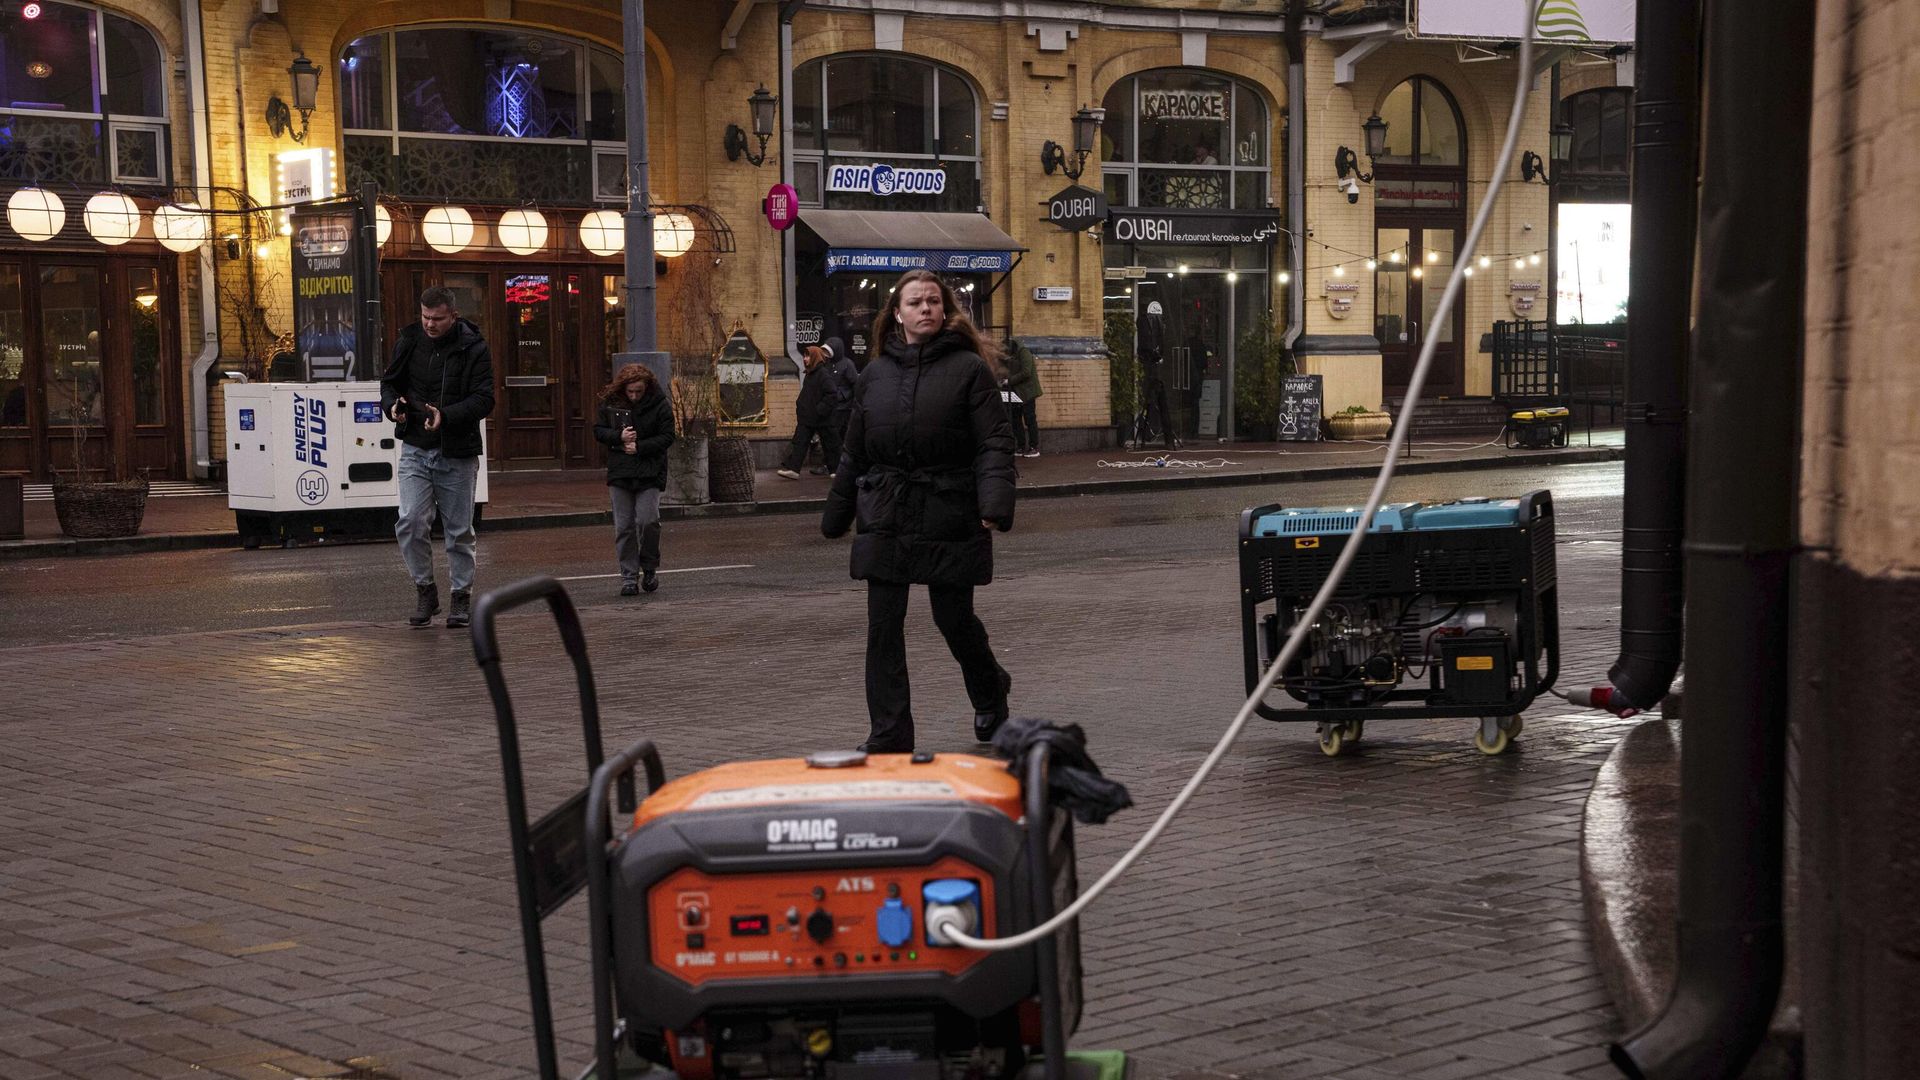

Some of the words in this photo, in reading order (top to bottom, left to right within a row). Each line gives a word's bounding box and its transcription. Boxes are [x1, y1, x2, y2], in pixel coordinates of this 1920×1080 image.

[1143, 94, 1222, 117] КАРАОКЕ
[833, 168, 870, 189] ASIA
[896, 171, 943, 191] FOODS
[771, 194, 787, 209] TIKI
[1051, 197, 1095, 219] DUBAI
[1116, 218, 1172, 241] DUBAI
[1173, 234, 1211, 242] restaurant
[1212, 232, 1240, 242] karaoke
[1240, 233, 1253, 242] bar
[1253, 221, 1277, 242] دبي
[314, 257, 340, 271] ДИНАМО
[851, 253, 888, 266] АЗІЙСЬКИХ
[891, 256, 925, 267] ПРОДУКТІВ
[948, 256, 968, 268] ASIA
[977, 256, 1000, 269] FOODS
[294, 392, 307, 463] ENERGY
[309, 398, 328, 468] PLUS
[836, 877, 875, 893] ATS
